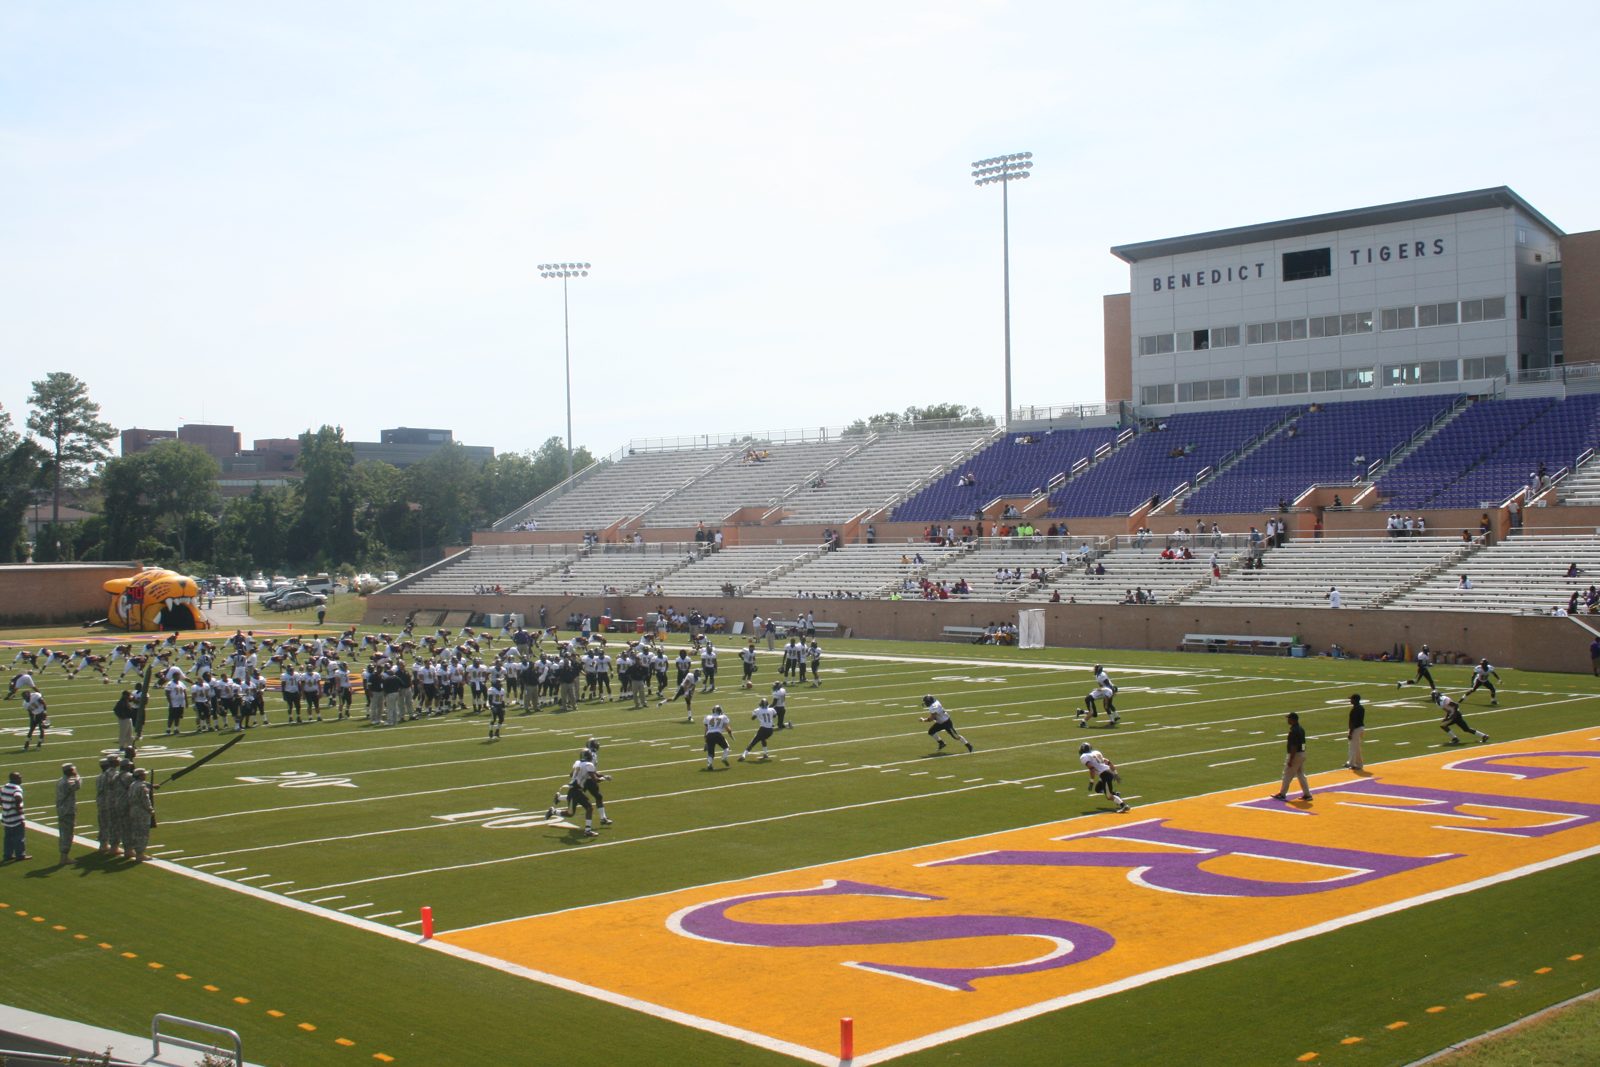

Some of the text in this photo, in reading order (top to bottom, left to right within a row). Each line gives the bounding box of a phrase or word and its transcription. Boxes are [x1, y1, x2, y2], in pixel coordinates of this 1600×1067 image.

[1153, 238, 1445, 292] BENEDICT TIGERS
[430, 806, 566, 829] 10
